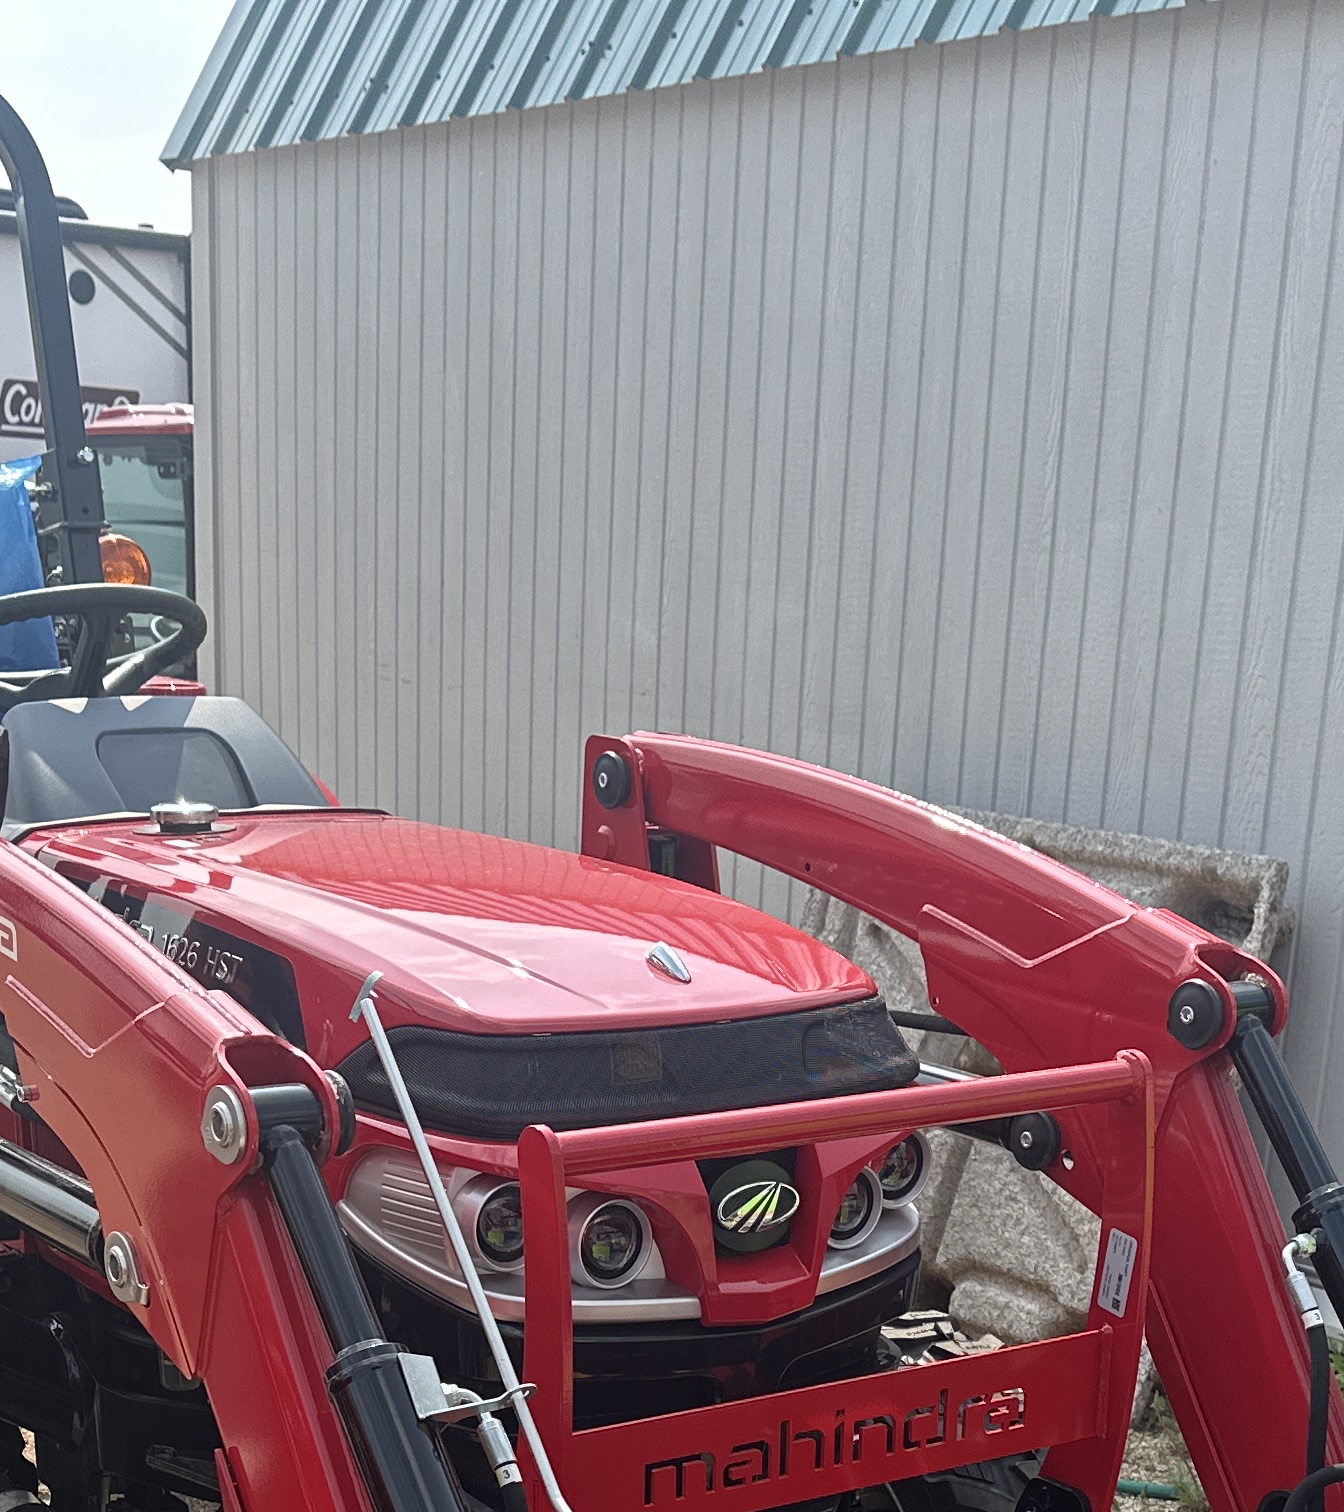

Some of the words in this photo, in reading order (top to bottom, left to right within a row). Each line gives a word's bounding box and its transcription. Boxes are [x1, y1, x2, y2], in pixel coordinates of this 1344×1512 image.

[161, 932, 201, 969] 1626
[203, 945, 244, 984] HST
[643, 1387, 1025, 1508] mahindra
[502, 1469, 511, 1480] 3
